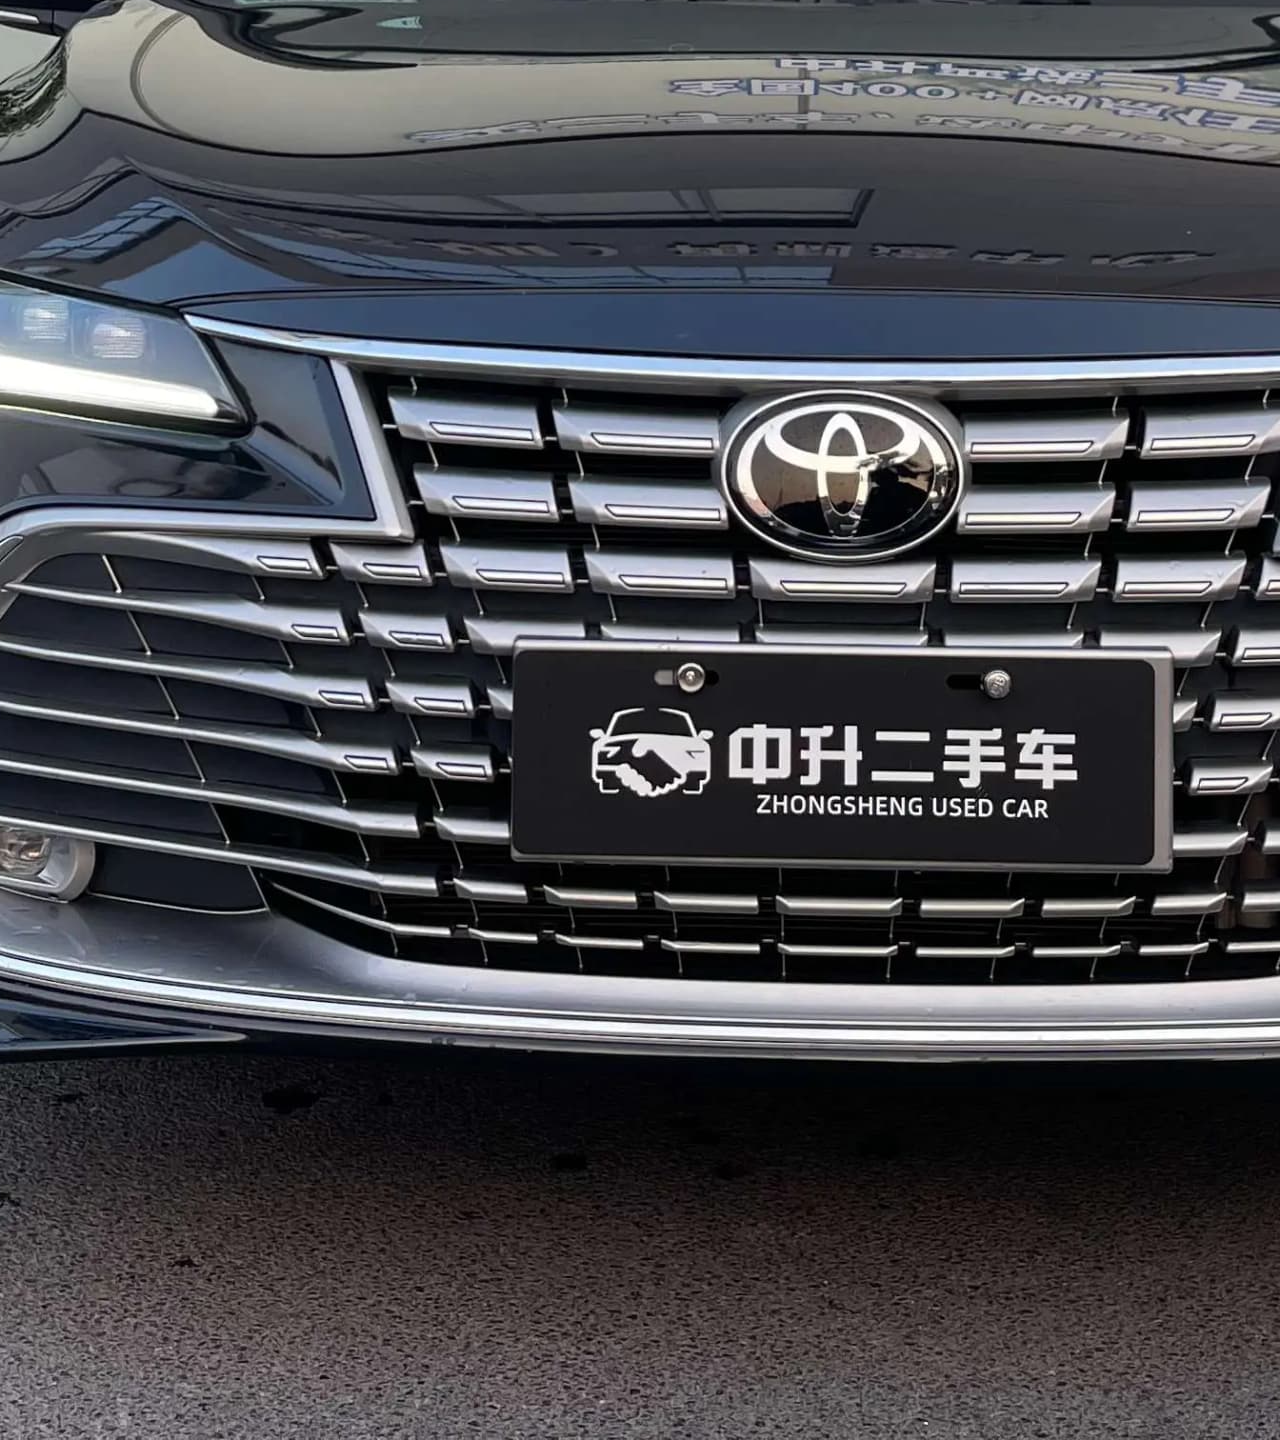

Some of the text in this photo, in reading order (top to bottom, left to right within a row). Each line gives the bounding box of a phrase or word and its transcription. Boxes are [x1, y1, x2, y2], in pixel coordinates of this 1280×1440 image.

[728, 723, 1078, 790] 中升二手车
[756, 793, 1049, 819] ZHONGSHENG USED CAR
